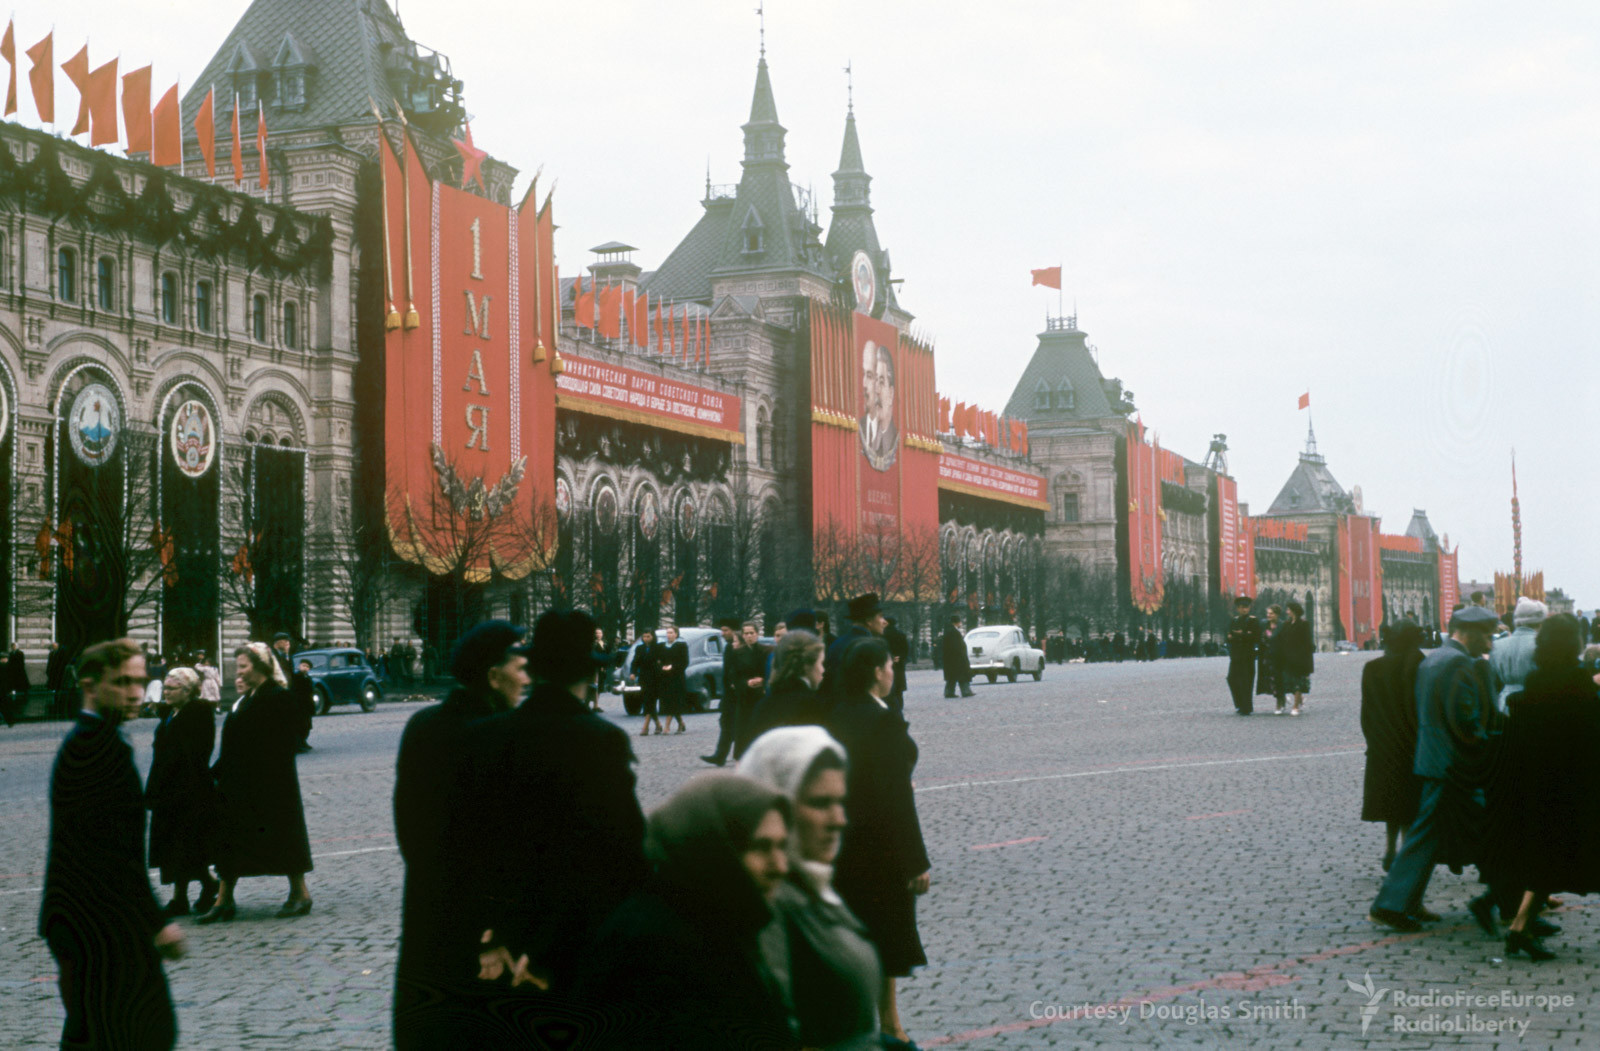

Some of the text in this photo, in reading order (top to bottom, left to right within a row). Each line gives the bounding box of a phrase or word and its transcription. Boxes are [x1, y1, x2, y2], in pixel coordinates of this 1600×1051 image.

[463, 216, 492, 452] 1 МАЯ
[631, 375, 656, 394] ПАРТИЯ
[659, 383, 698, 403] СОВЕТСКОГО
